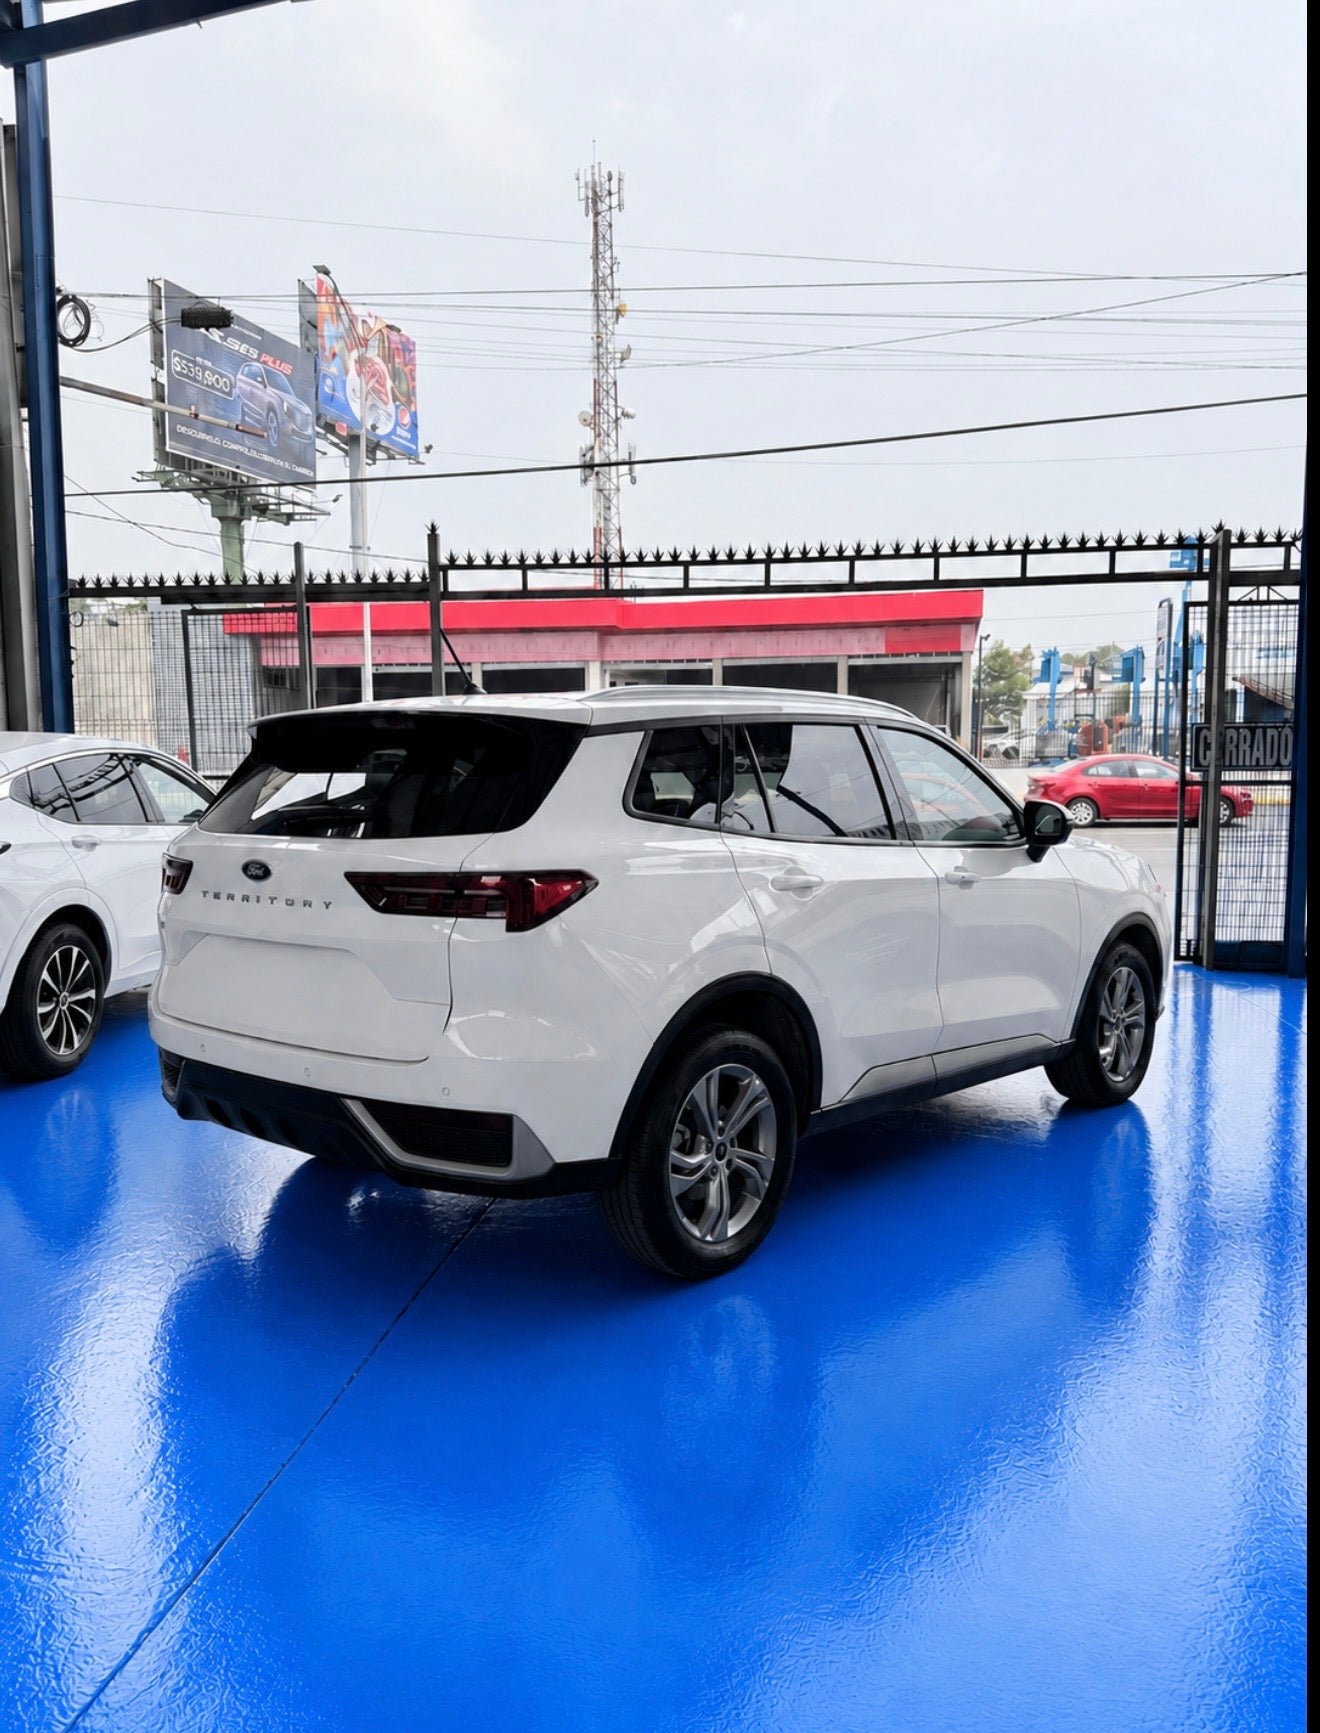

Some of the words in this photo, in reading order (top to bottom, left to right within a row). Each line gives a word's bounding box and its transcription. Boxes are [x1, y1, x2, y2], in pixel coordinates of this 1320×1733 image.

[260, 353, 294, 375] PLUS
[1199, 727, 1294, 767] CRRADO
[201, 890, 333, 910] TERRITORY
